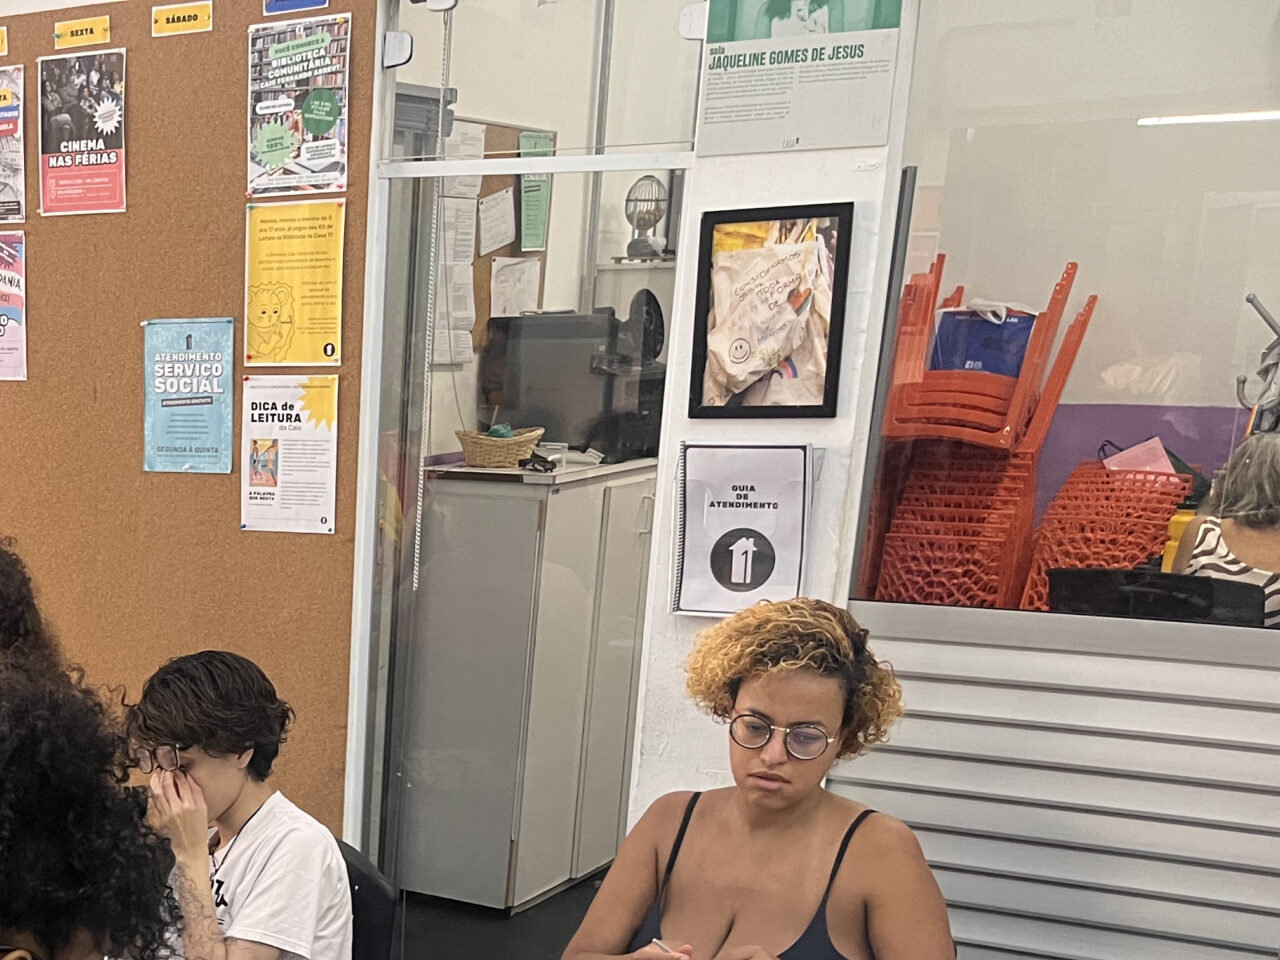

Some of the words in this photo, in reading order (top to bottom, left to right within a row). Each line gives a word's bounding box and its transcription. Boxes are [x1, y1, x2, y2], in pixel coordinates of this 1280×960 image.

[165, 14, 199, 24] SÁBADO
[70, 27, 95, 38] SEXTA
[709, 45, 726, 56] sala
[271, 48, 326, 68] BIBLIOTECA
[708, 51, 766, 72] JAQUELINE
[769, 48, 808, 65] GOMES
[811, 47, 826, 61] DE
[828, 44, 865, 61] JESUS
[268, 56, 331, 79] COMUNITÁRIA
[260, 78, 276, 89] CAIO
[277, 71, 313, 85] FERNANDO
[60, 138, 106, 152] CINEMA
[48, 155, 72, 168] NAS
[75, 151, 118, 167] FÉRIAS
[756, 279, 780, 296] TODA
[769, 273, 802, 298] FORMA
[154, 351, 222, 362] ATENDIMENTO
[154, 377, 225, 394] SOCIAL
[251, 401, 278, 411] DICA
[281, 401, 295, 411] de
[251, 413, 302, 423] LEITURA
[194, 446, 219, 454] QUINTA
[708, 501, 779, 510] ATENDIMENTO
